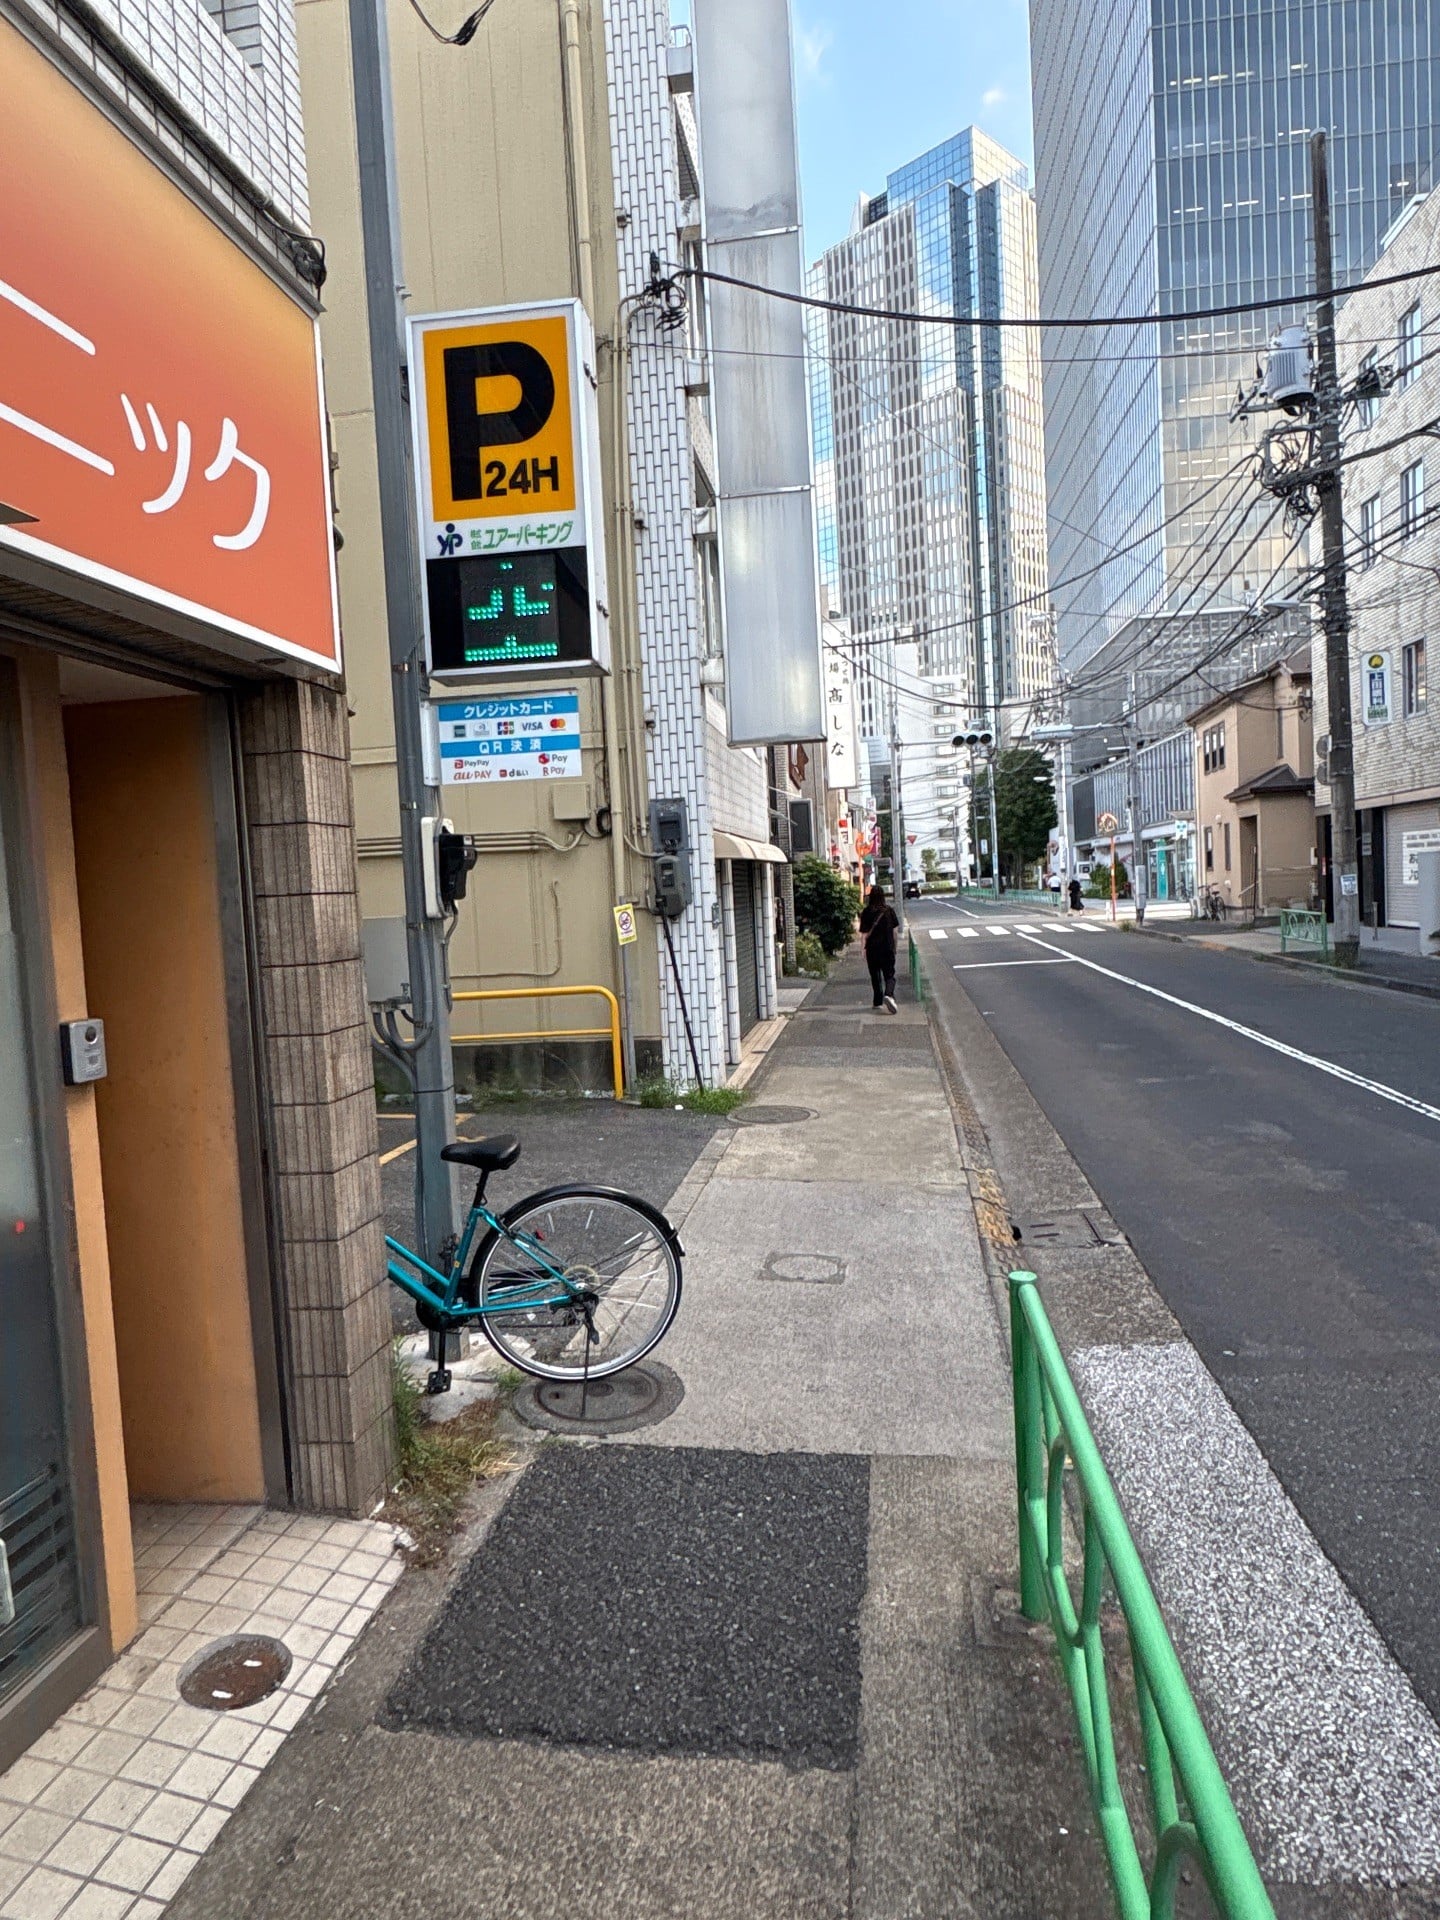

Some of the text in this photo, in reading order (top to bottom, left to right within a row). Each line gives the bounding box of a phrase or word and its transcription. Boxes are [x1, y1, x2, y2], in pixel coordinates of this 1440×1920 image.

[443, 341, 555, 501] P
[485, 456, 559, 497] 24H
[464, 701, 554, 718] クレジットカード
[522, 721, 543, 731] VISA
